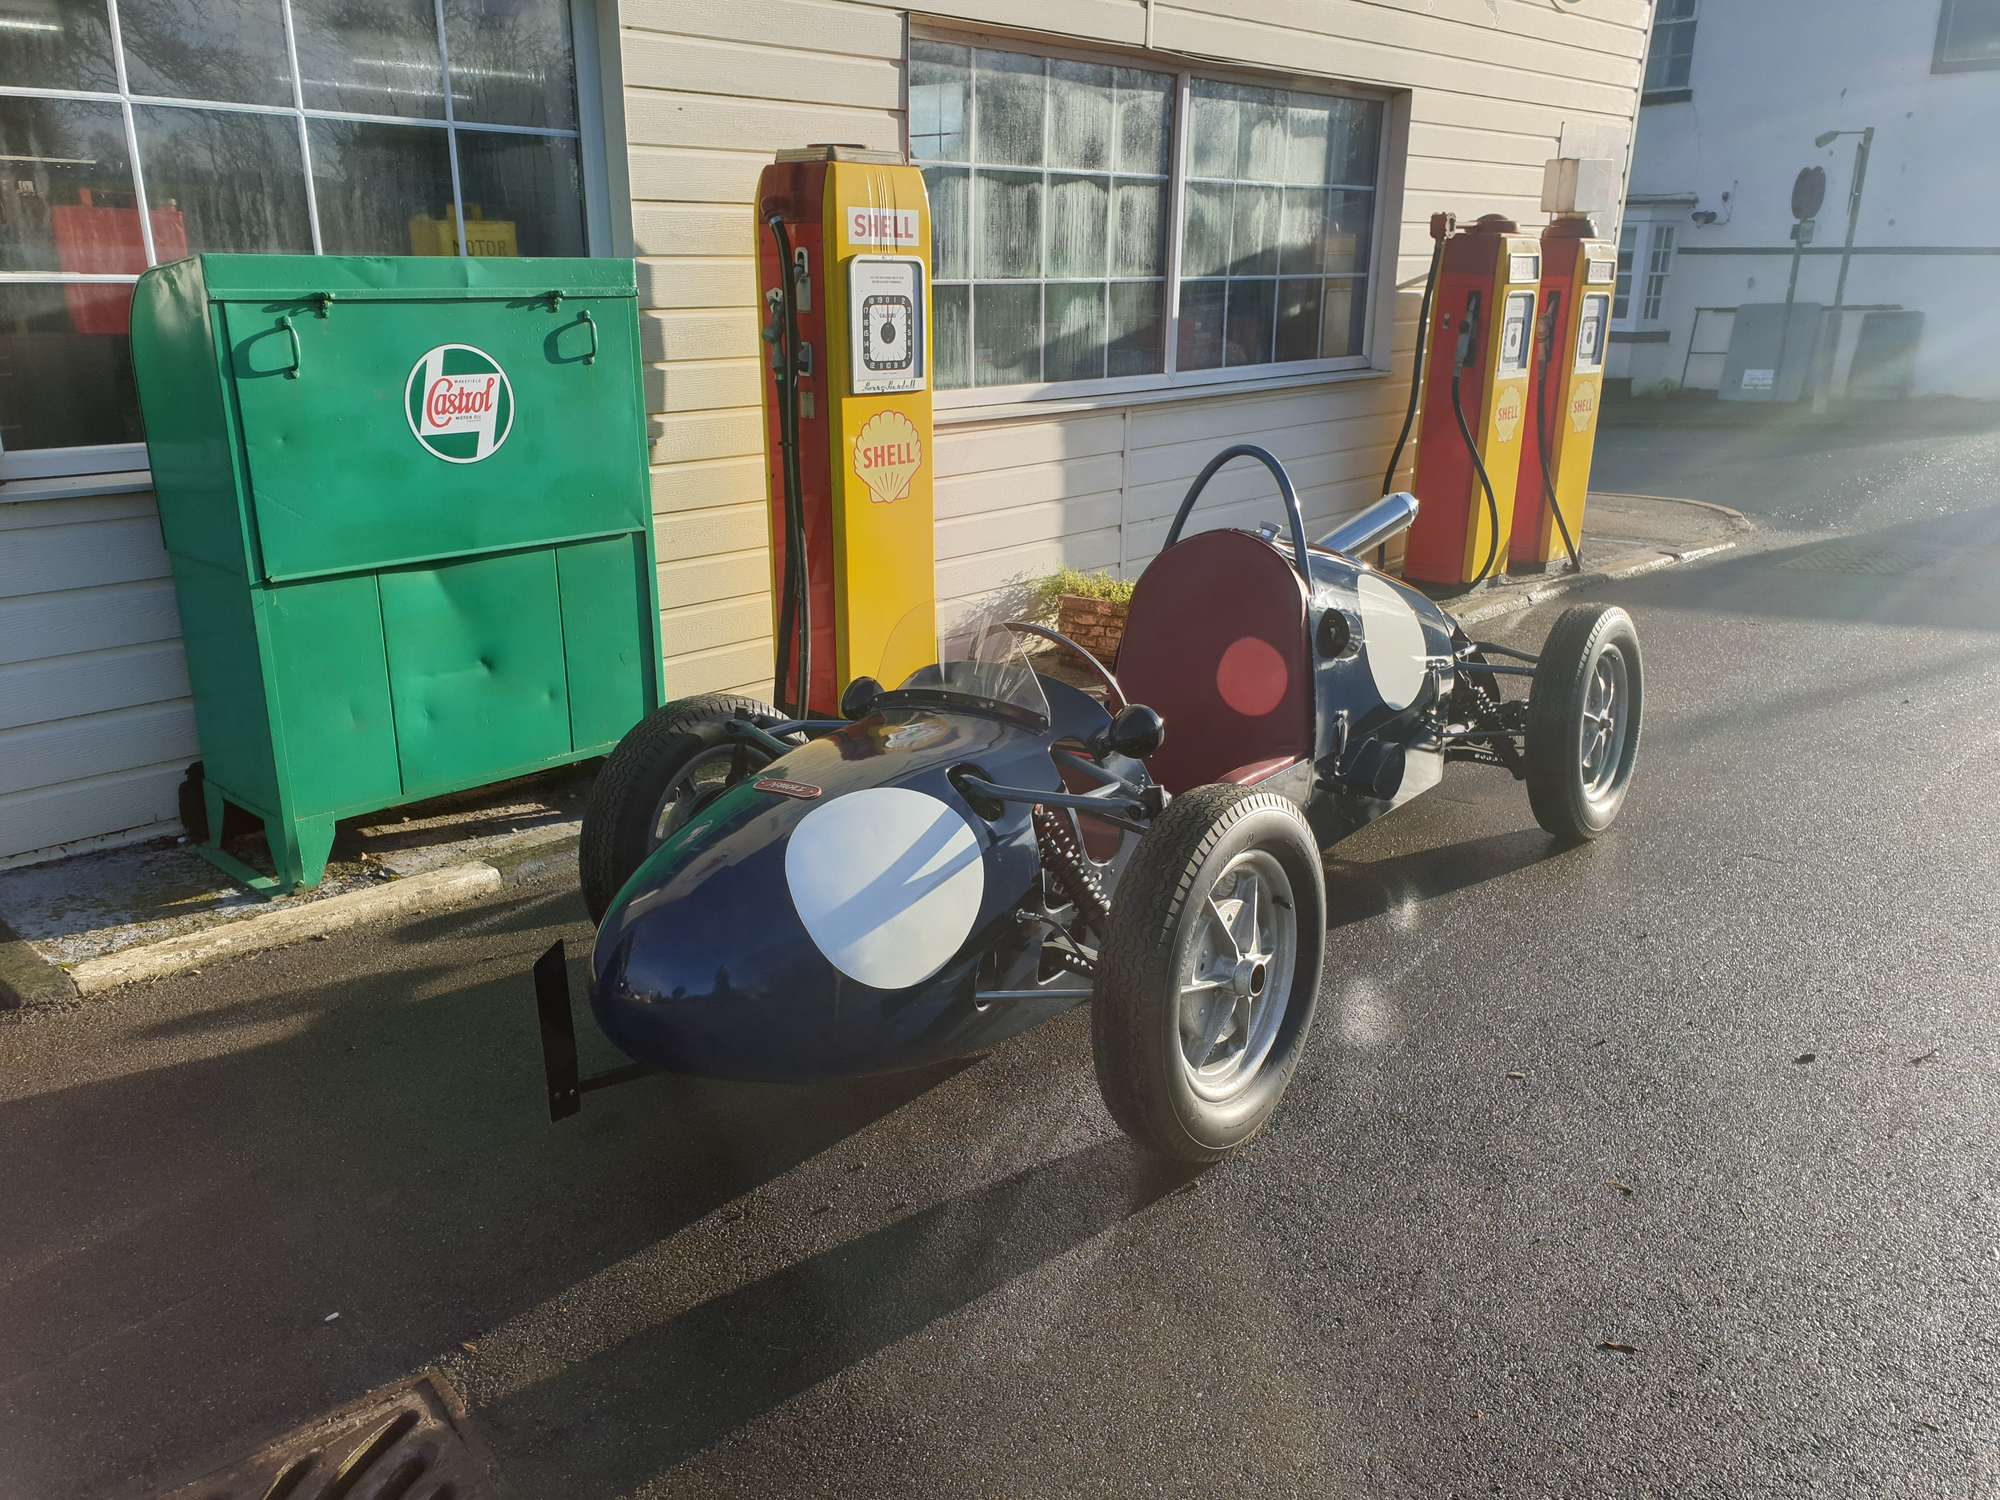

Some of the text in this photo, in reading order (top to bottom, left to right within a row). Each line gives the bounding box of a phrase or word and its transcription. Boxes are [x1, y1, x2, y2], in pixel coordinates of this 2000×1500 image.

[854, 214, 914, 239] SHELL
[426, 377, 495, 428] Castrol
[1498, 405, 1518, 421] SHELL
[1573, 398, 1592, 414] SHELL
[863, 442, 915, 469] SHELL
